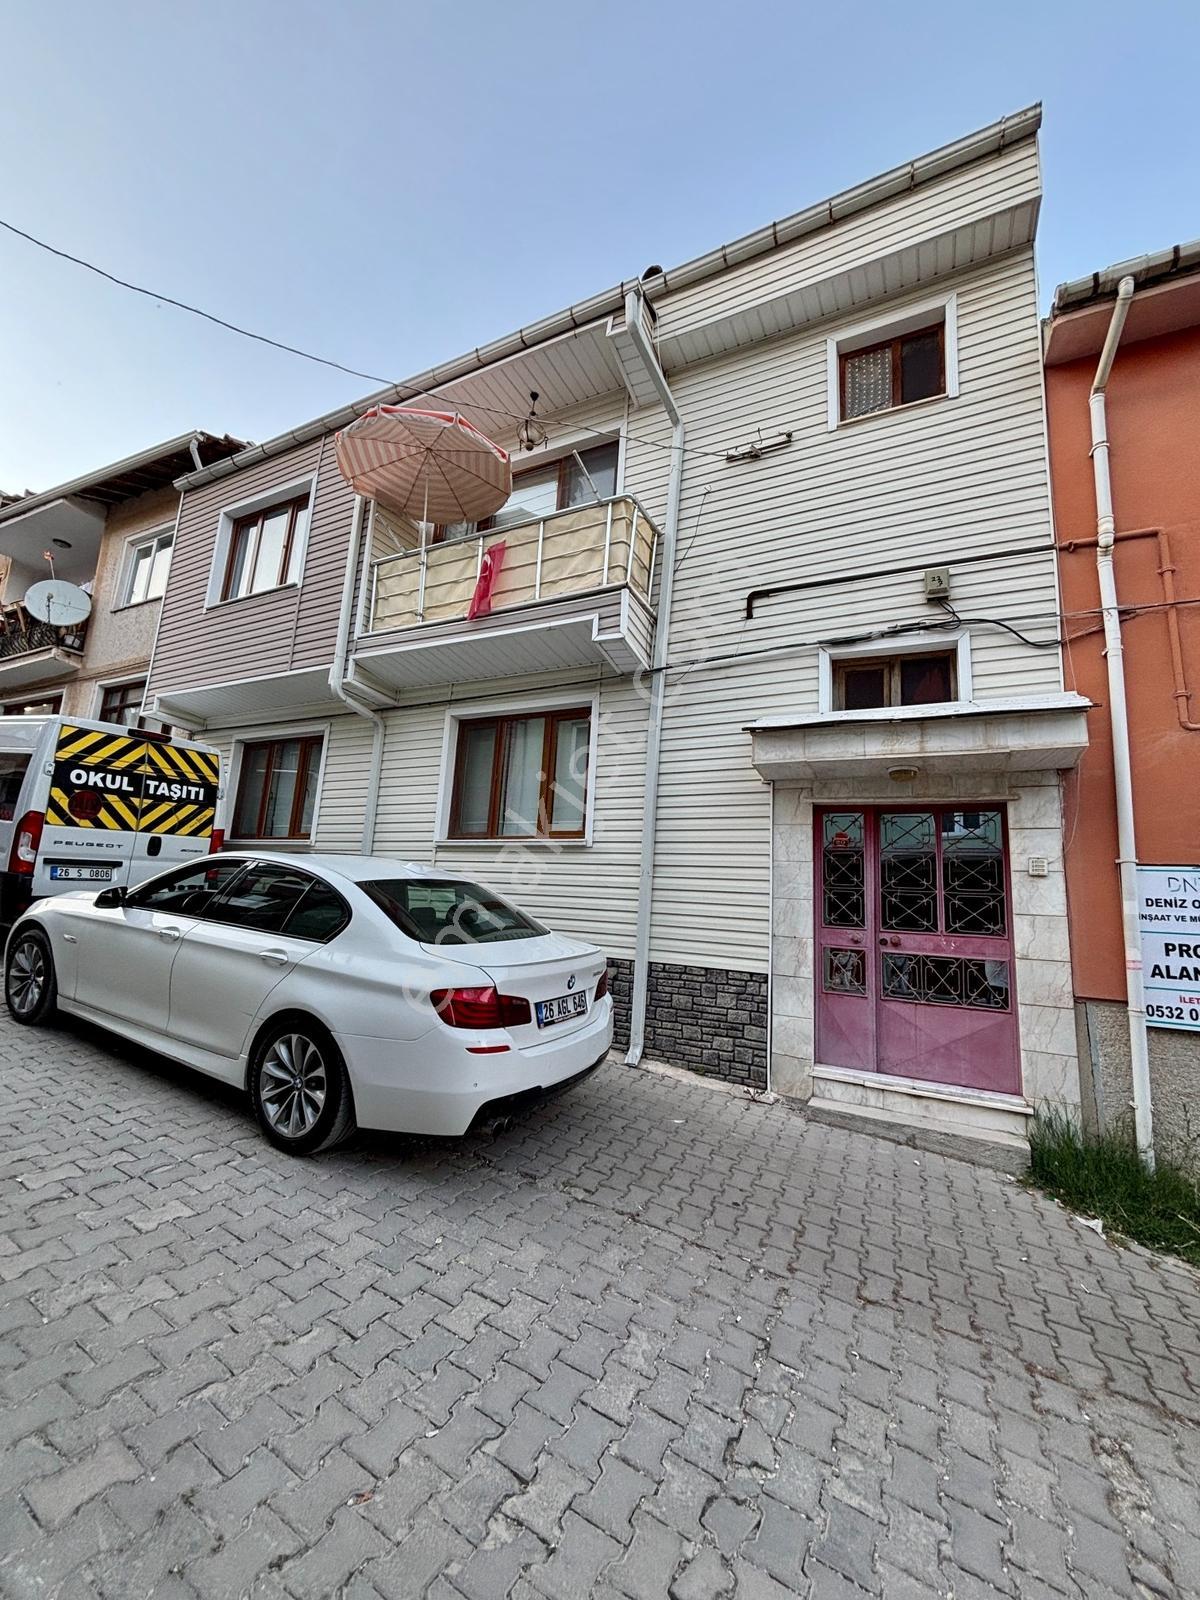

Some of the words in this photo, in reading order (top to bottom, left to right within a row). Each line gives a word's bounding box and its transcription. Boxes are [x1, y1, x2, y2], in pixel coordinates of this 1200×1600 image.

[69, 769, 134, 792] OKUL
[146, 780, 204, 801] TAŞITI
[53, 840, 124, 849] PEUGEOT
[58, 868, 70, 877] 26
[77, 868, 83, 877] S
[89, 869, 110, 878] 0806
[1145, 896, 1188, 909] DENİZ
[1138, 911, 1171, 923] İNŞAAT
[1174, 914, 1187, 922] VE
[1189, 915, 1200, 923] M
[543, 1002, 555, 1020] 26
[557, 998, 571, 1016] AGL
[1145, 1004, 1185, 1020] 0532
